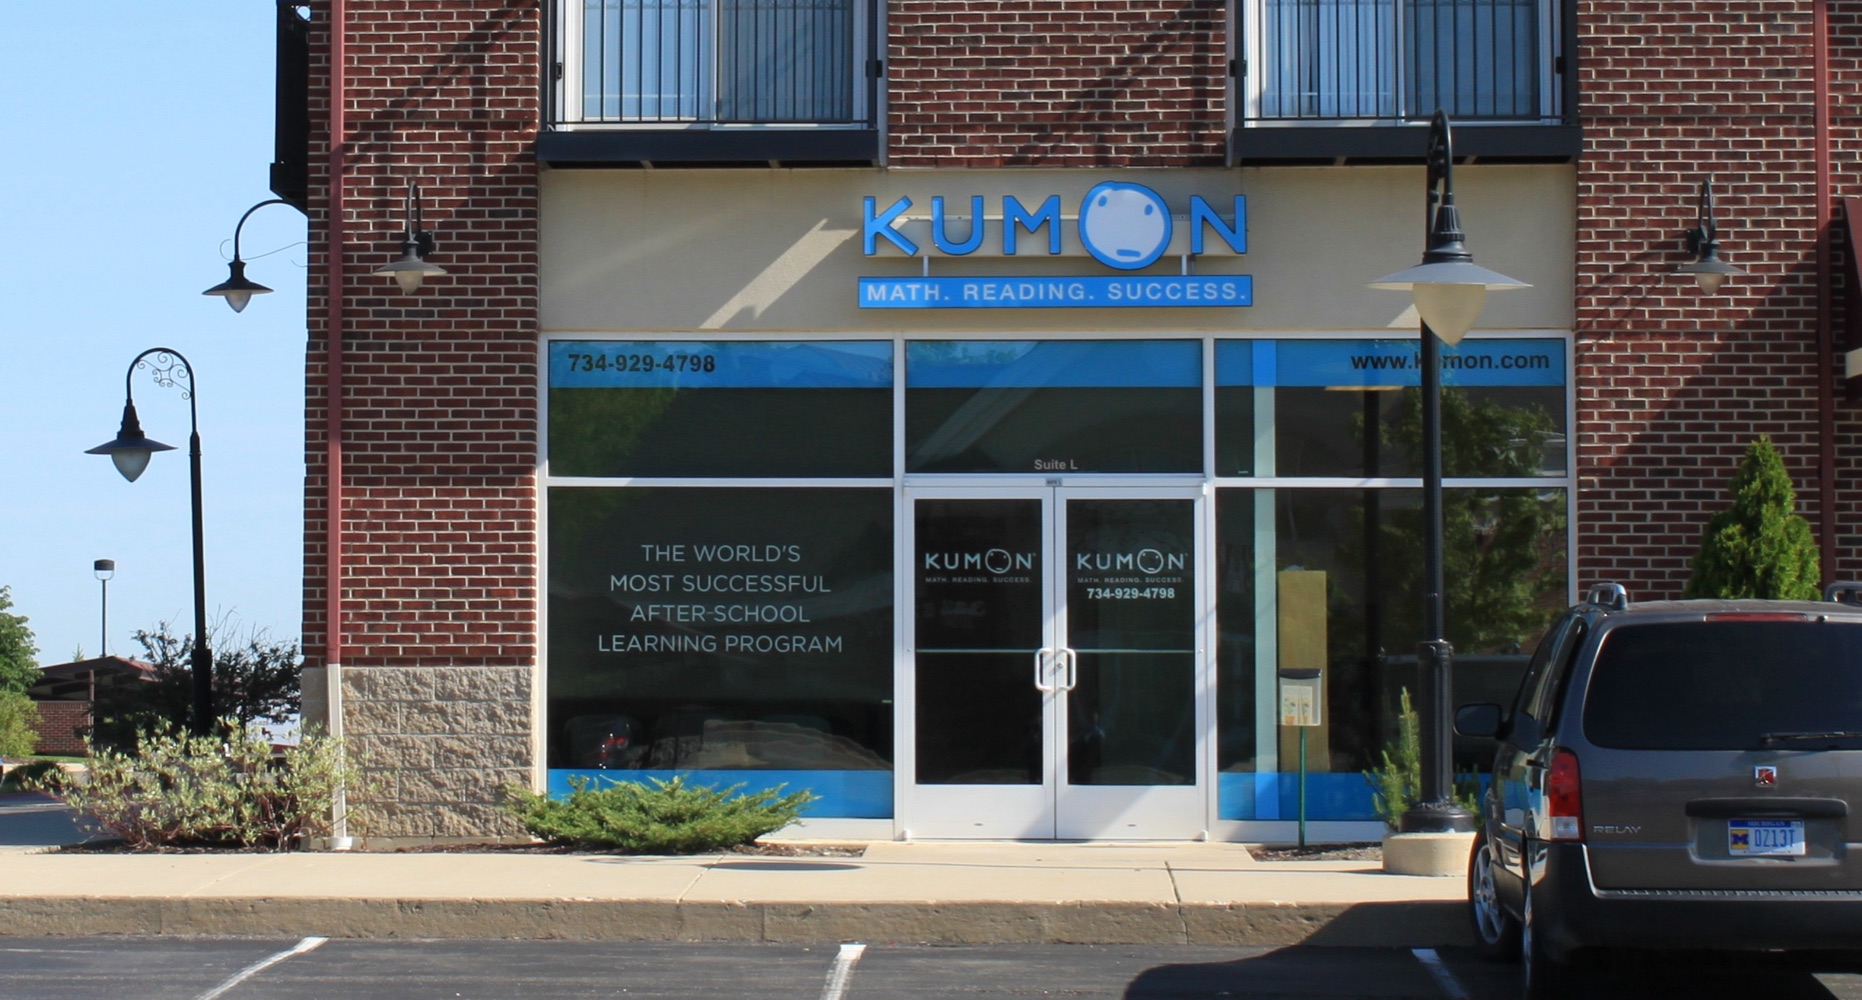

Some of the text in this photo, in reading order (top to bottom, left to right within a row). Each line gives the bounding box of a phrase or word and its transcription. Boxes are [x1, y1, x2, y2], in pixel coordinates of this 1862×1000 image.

[862, 180, 1248, 270] KUMON
[866, 283, 1247, 301] MATH. READING. SUCCESS.
[568, 354, 716, 373] 734-929-4798
[1034, 459, 1079, 470] Suite L
[641, 545, 801, 562] THE WORLD'S
[925, 548, 1032, 574] KUMON
[1077, 548, 1184, 574] KUMON
[610, 575, 831, 593] MOST SUCCESSFUL
[1087, 588, 1175, 599] 734-929-4798
[630, 604, 811, 623] AFTER-SCHOOL
[598, 635, 843, 653] LEARNING PROGRAM
[1593, 825, 1642, 834] RELAY
